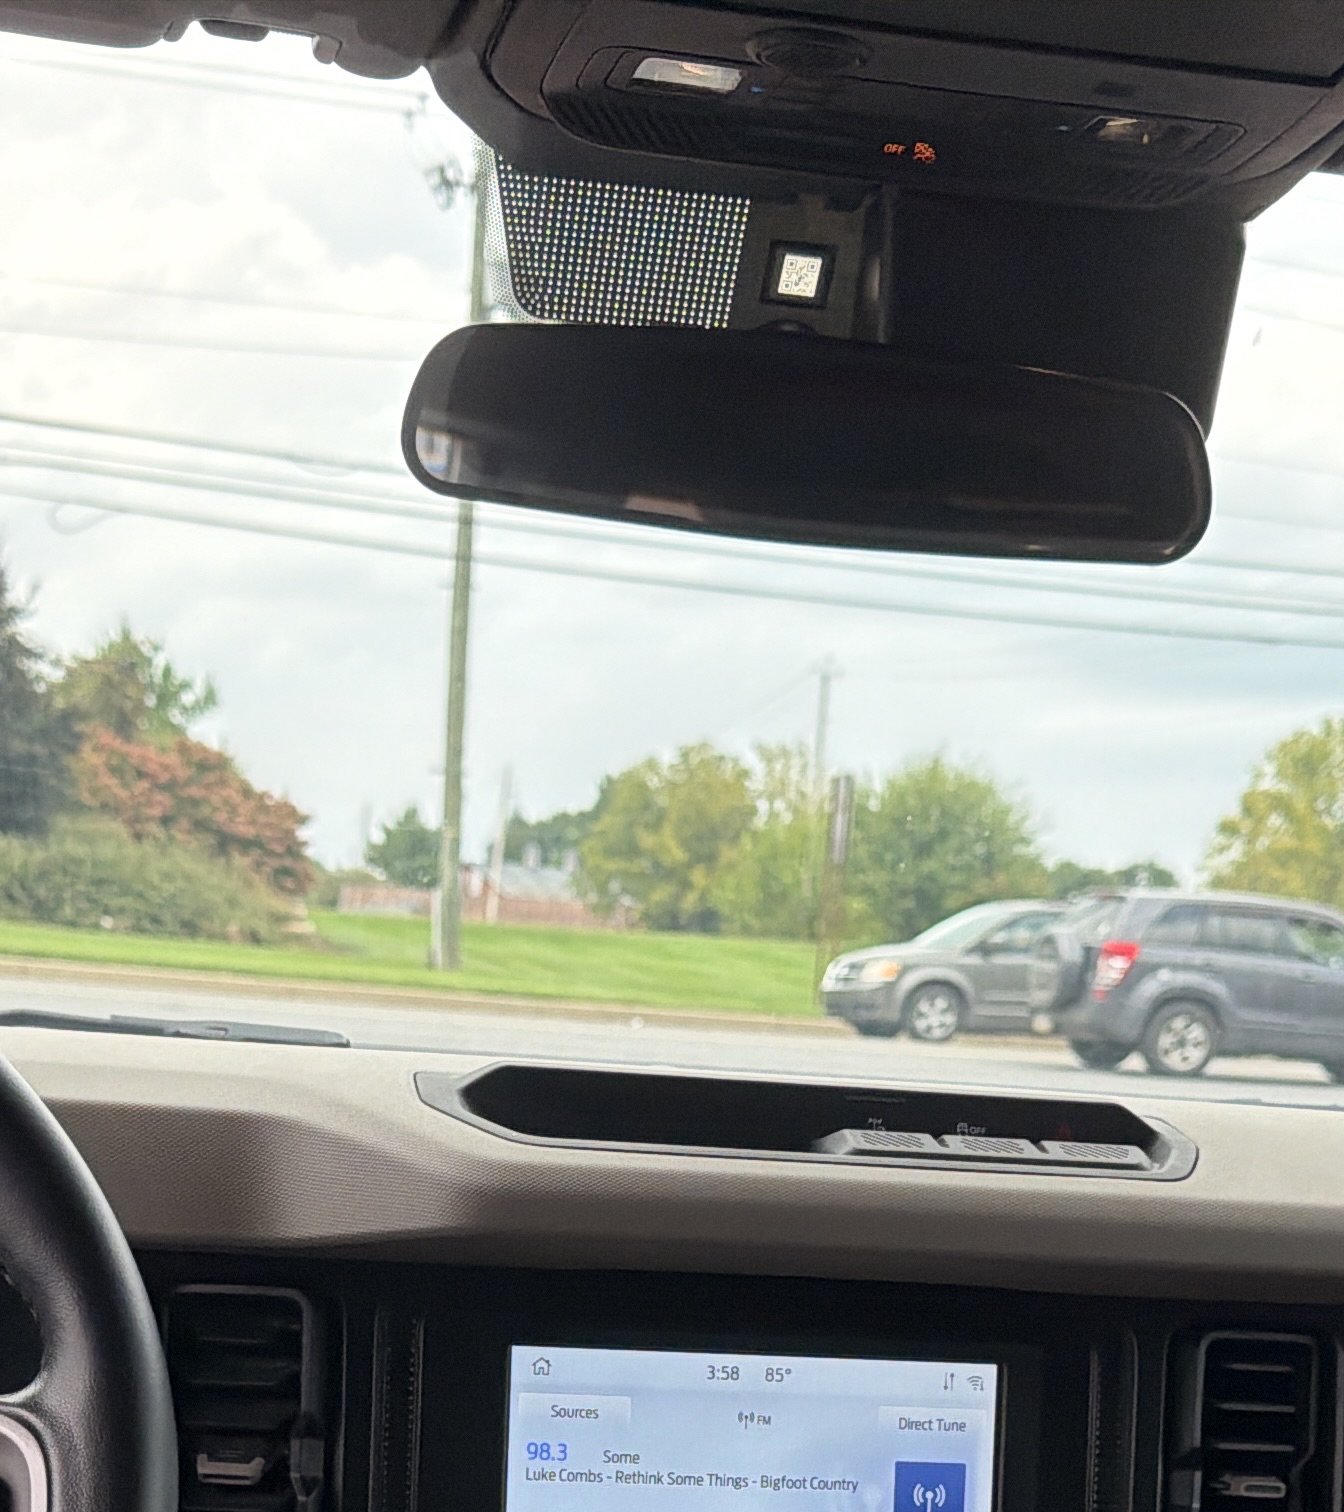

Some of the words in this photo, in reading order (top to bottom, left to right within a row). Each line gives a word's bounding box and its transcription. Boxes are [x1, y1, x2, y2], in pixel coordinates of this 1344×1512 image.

[884, 143, 906, 154] OFF
[706, 1365, 740, 1382] 3:58
[764, 1366, 792, 1383] 85°
[550, 1404, 599, 1421] Sources
[756, 1415, 772, 1426] FM
[898, 1417, 933, 1433] Direct
[936, 1418, 967, 1433] Tune
[526, 1442, 568, 1462] 98.3
[602, 1450, 640, 1465] Some
[525, 1467, 556, 1482] Luke
[558, 1468, 603, 1484] Combs
[615, 1470, 664, 1486] Rethink
[667, 1472, 705, 1487] Some
[706, 1473, 749, 1491] Things
[760, 1474, 807, 1493] Bigfoot
[809, 1476, 859, 1495] Country
